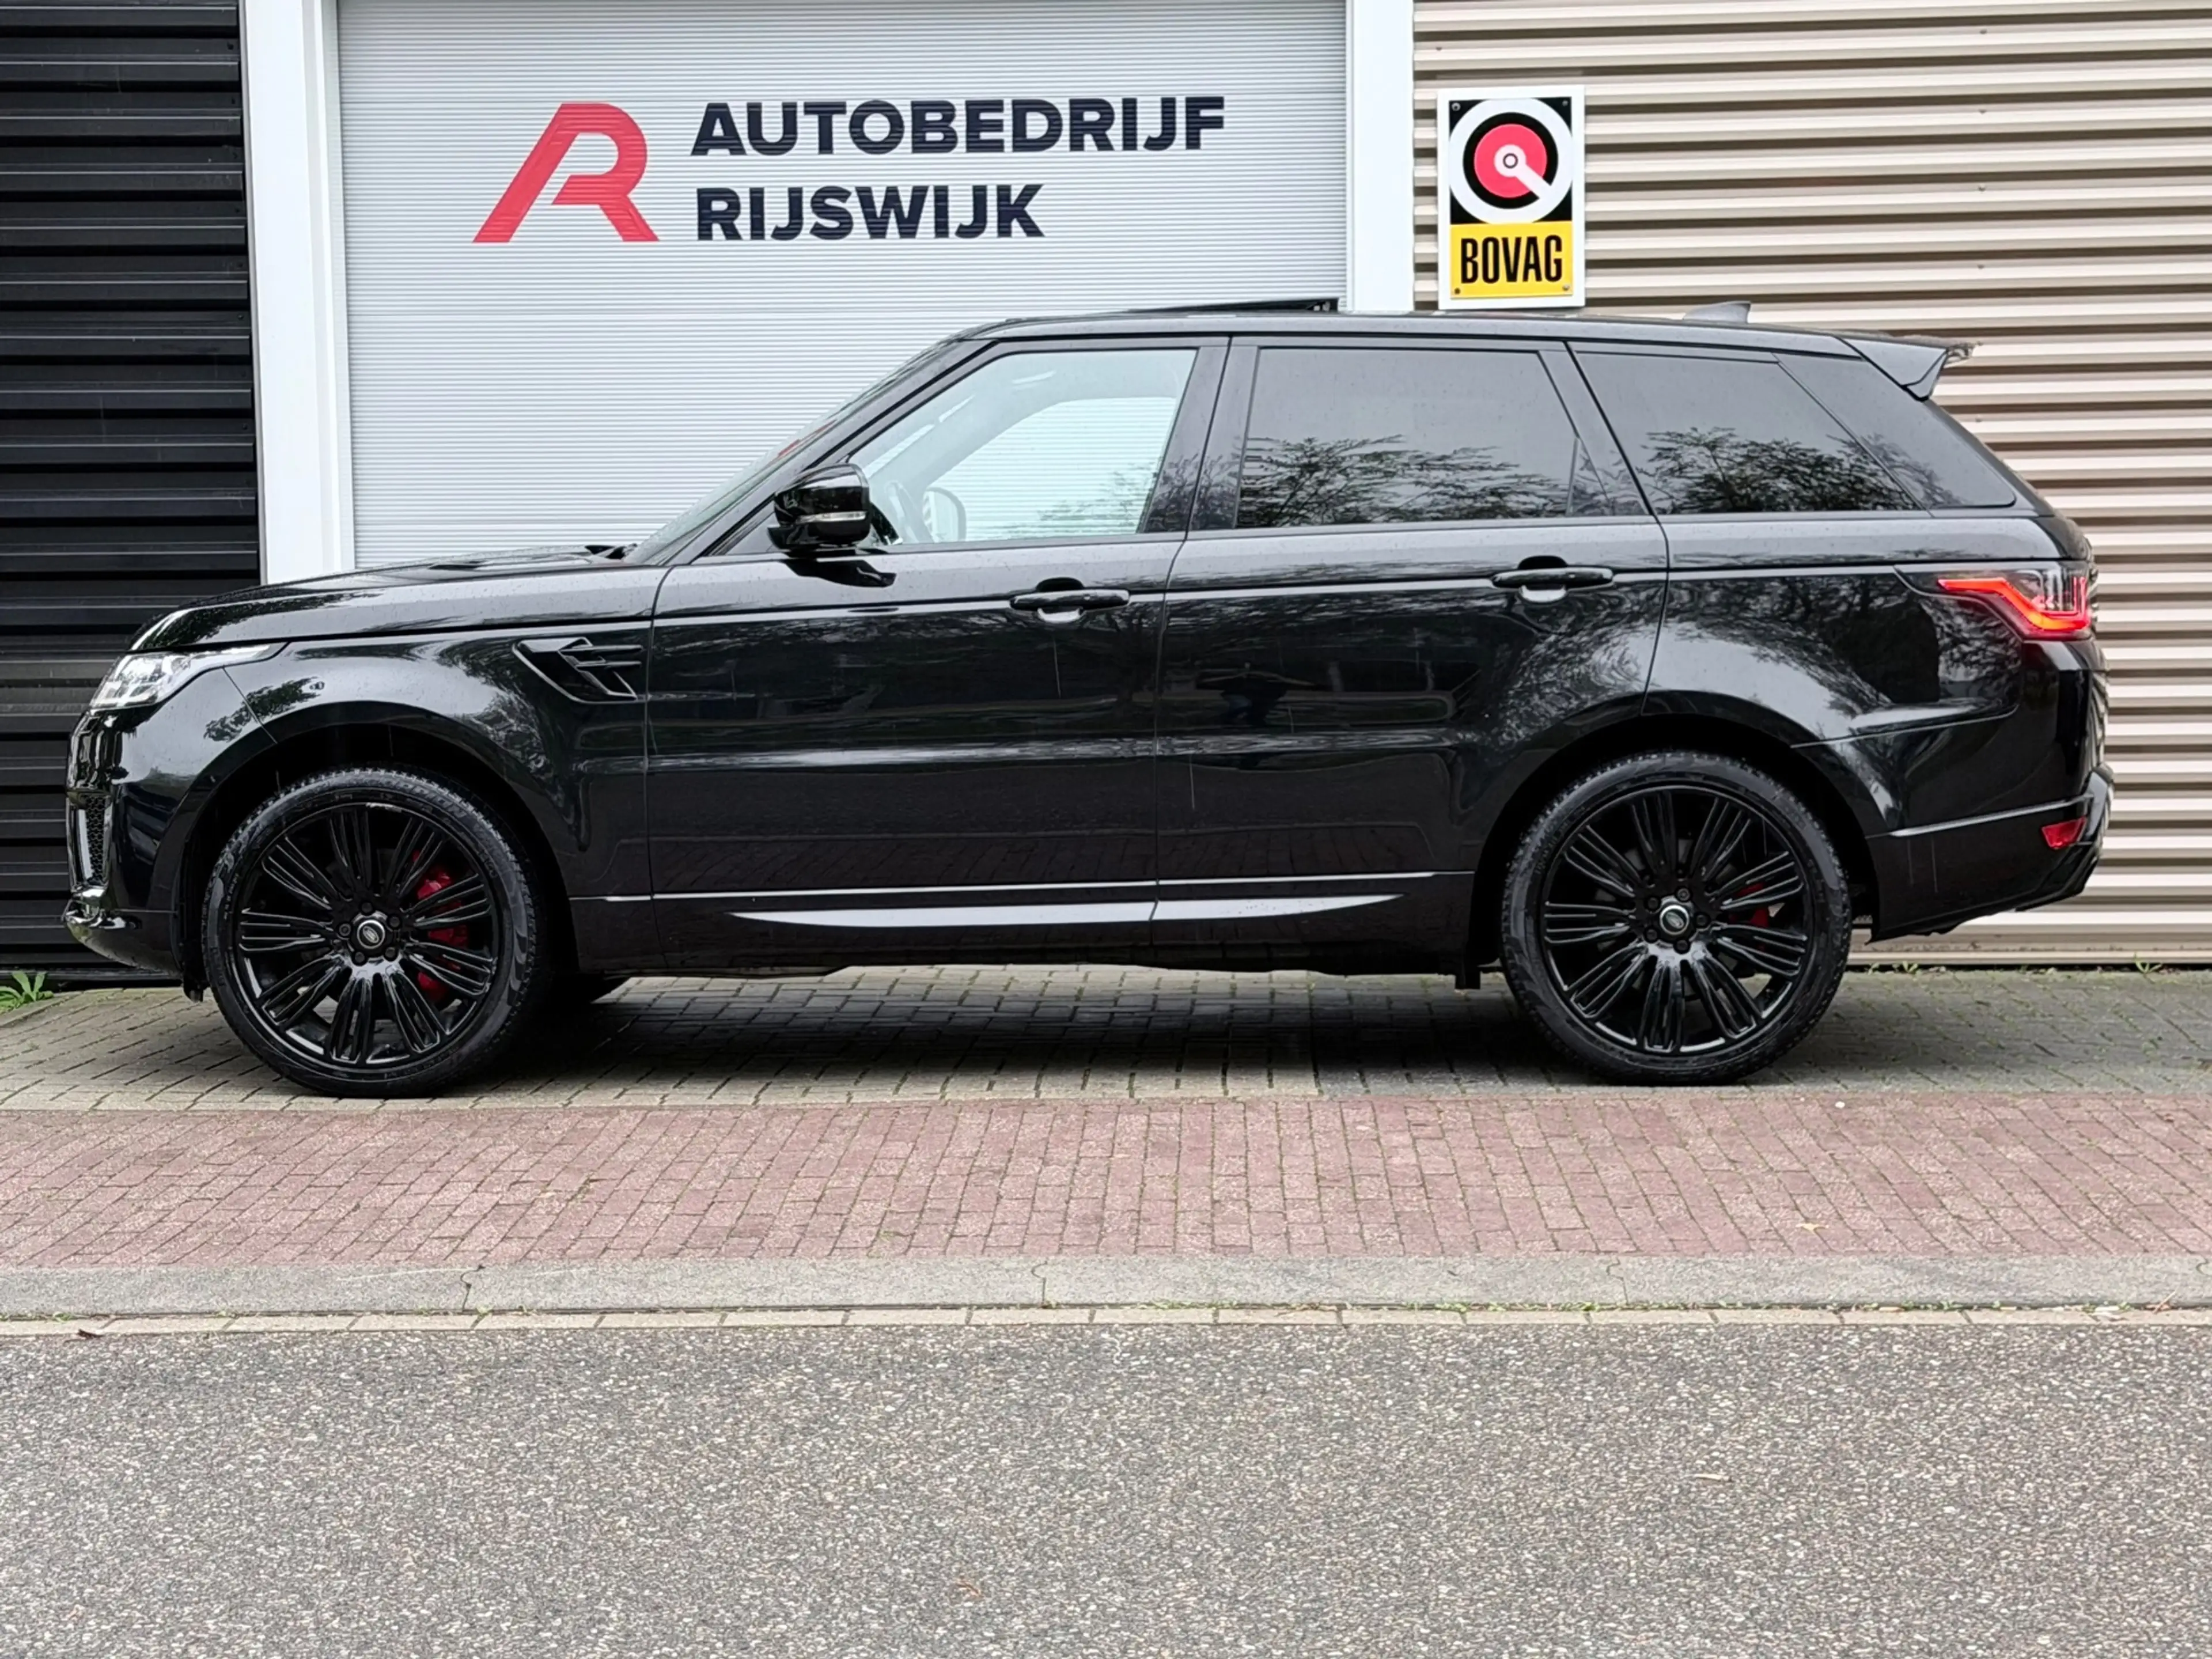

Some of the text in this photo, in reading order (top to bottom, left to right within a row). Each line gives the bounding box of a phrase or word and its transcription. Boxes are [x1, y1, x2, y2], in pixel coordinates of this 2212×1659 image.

[691, 96, 1225, 156] AUTOBEDRIJF
[696, 184, 1044, 241] RIJSWIJK
[1460, 235, 1563, 284] BOVAG
